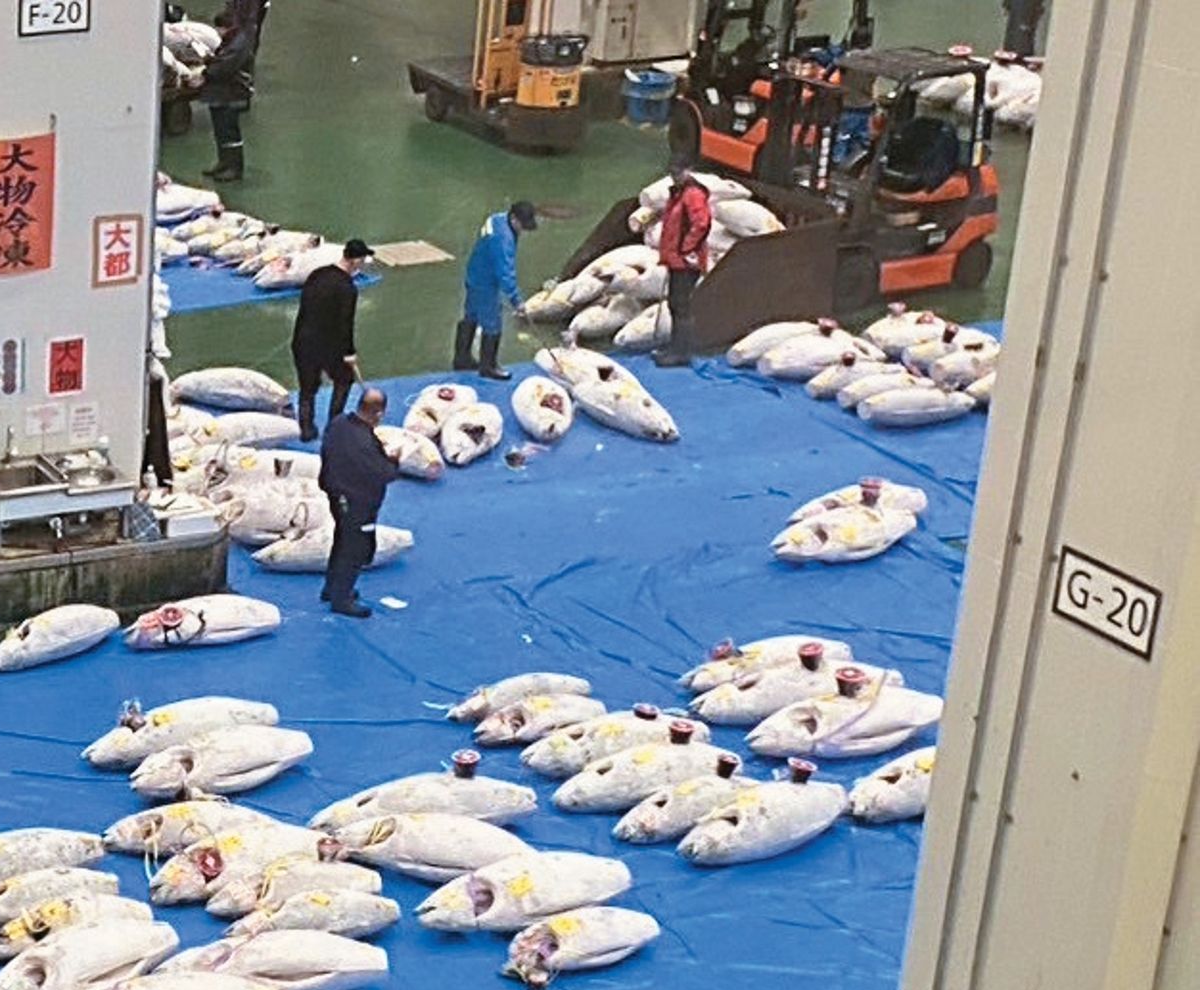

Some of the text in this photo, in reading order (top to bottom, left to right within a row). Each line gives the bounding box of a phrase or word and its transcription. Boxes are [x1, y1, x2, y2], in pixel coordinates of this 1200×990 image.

[28, 1, 82, 27] F-20
[103, 223, 132, 277] 大都
[1067, 570, 1148, 637] G-20
